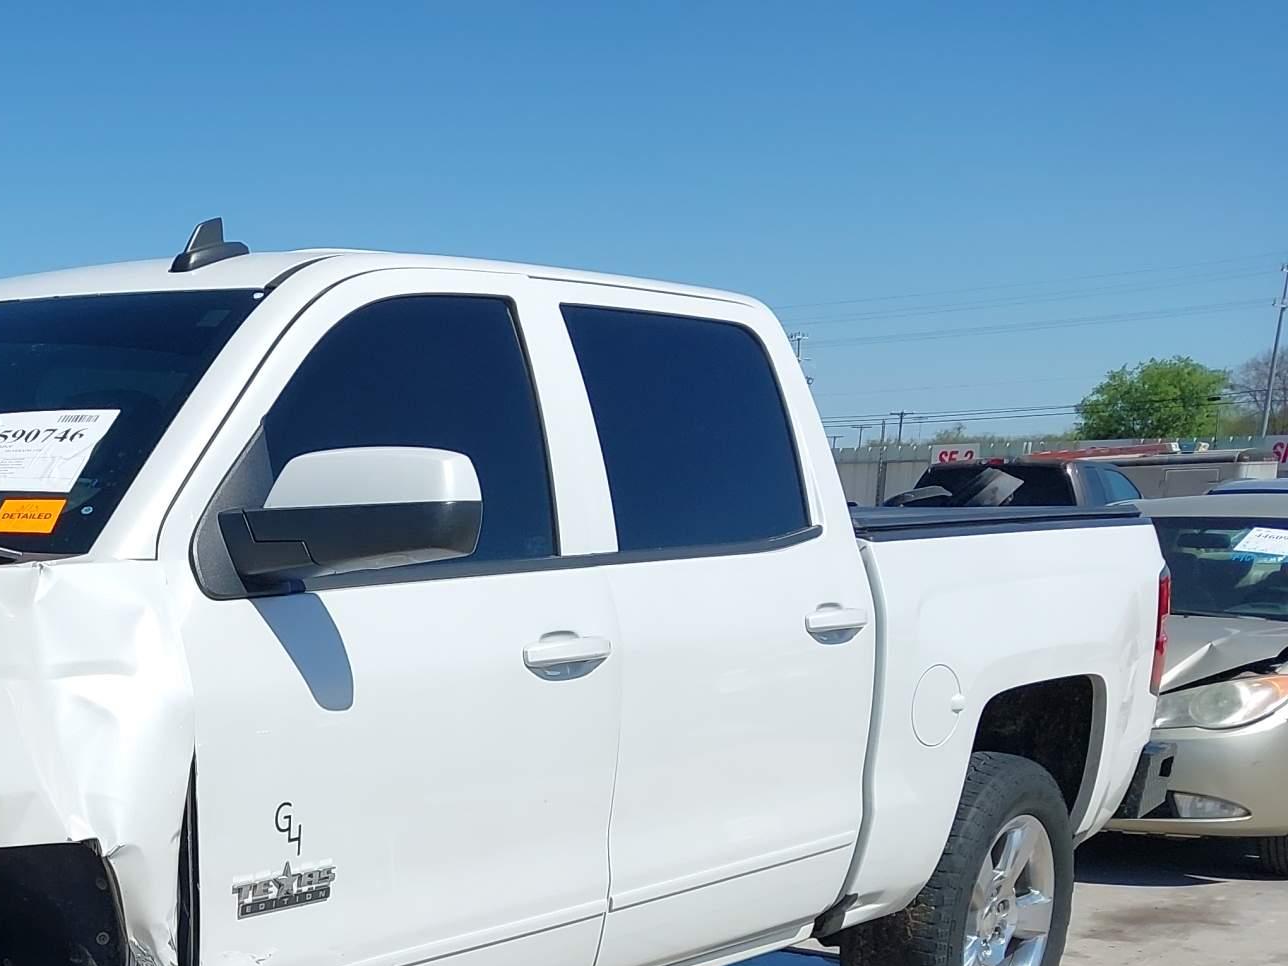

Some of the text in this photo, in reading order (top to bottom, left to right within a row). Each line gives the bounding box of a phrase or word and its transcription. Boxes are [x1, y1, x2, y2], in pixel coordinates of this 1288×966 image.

[1, 512, 52, 520] DETAILED
[232, 862, 336, 904] TEXAS
[245, 890, 326, 913] EDITION
